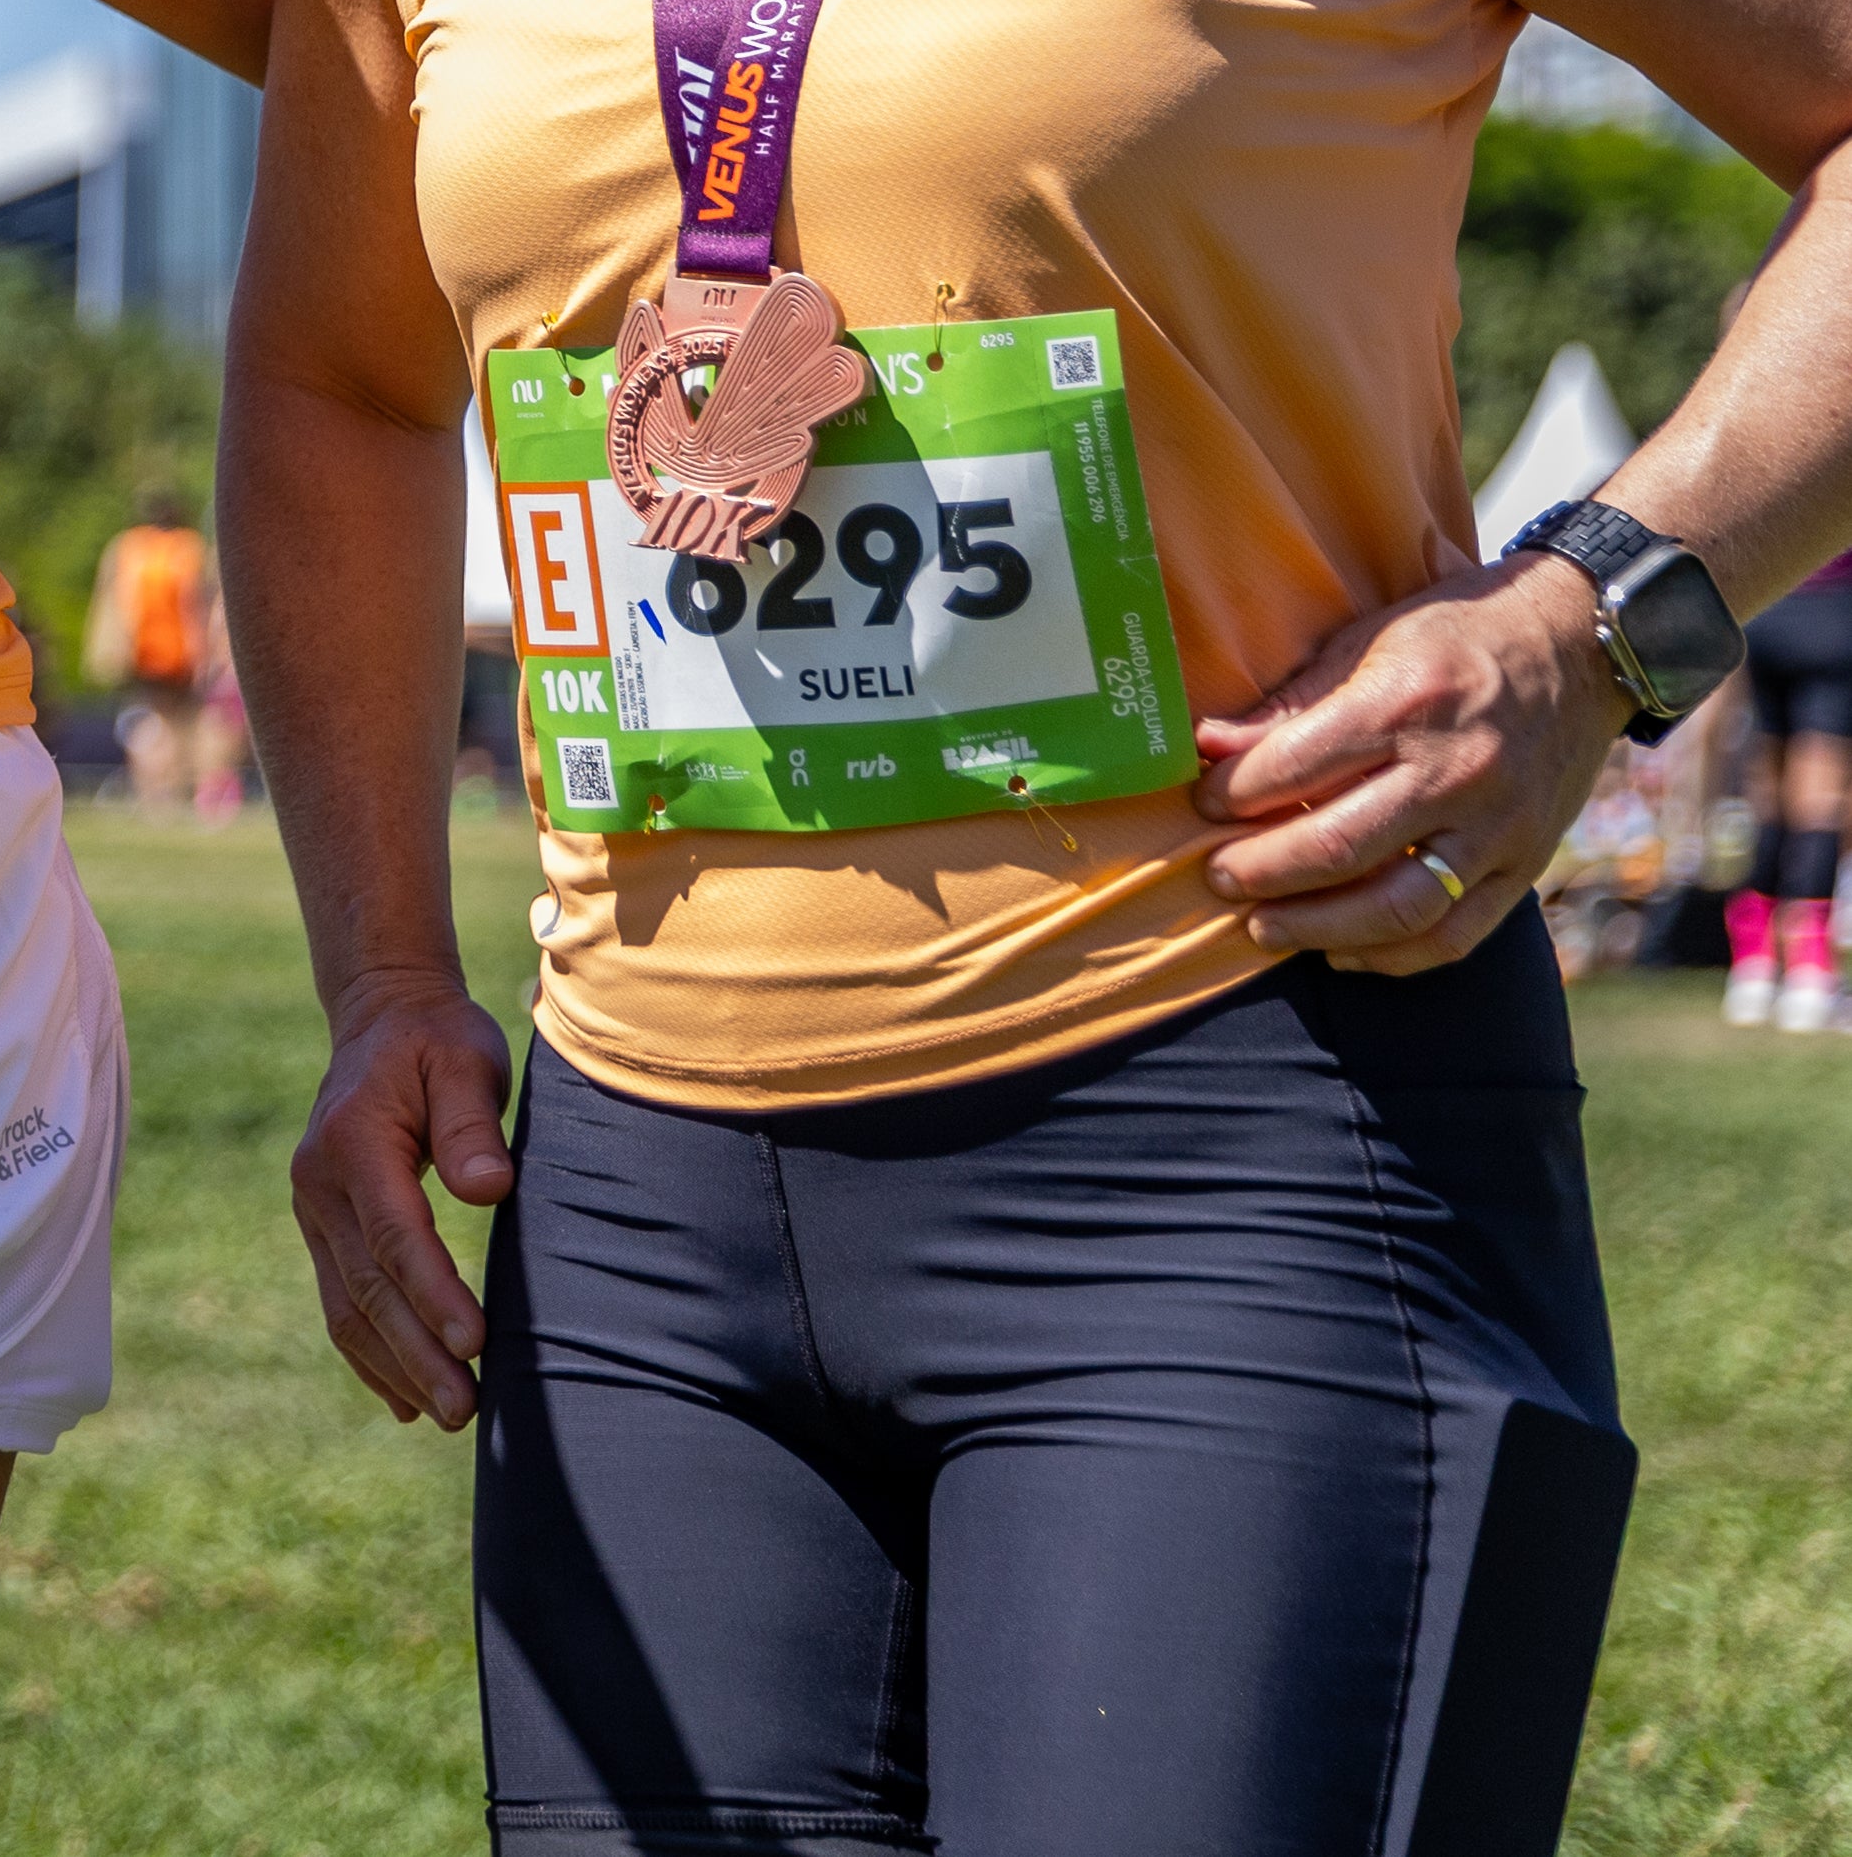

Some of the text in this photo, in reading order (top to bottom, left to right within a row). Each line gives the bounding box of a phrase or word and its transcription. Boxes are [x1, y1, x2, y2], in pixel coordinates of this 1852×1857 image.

[755, 93, 780, 155] HALF
[682, 337, 725, 356] 2025
[980, 333, 1014, 348] 6295
[1074, 422, 1107, 523] 11 955 006 296
[1092, 398, 1129, 541] TELEFONE DE EMERGÊNCIA
[529, 510, 576, 632] E
[666, 498, 1033, 637] 6295
[541, 670, 609, 714] 10K
[800, 666, 916, 700] SUELI
[1103, 657, 1140, 718] 6295
[1123, 612, 1167, 756] GUARDA-VOLUME
[847, 753, 897, 780] rvb
[941, 736, 1039, 772] BRASIL
